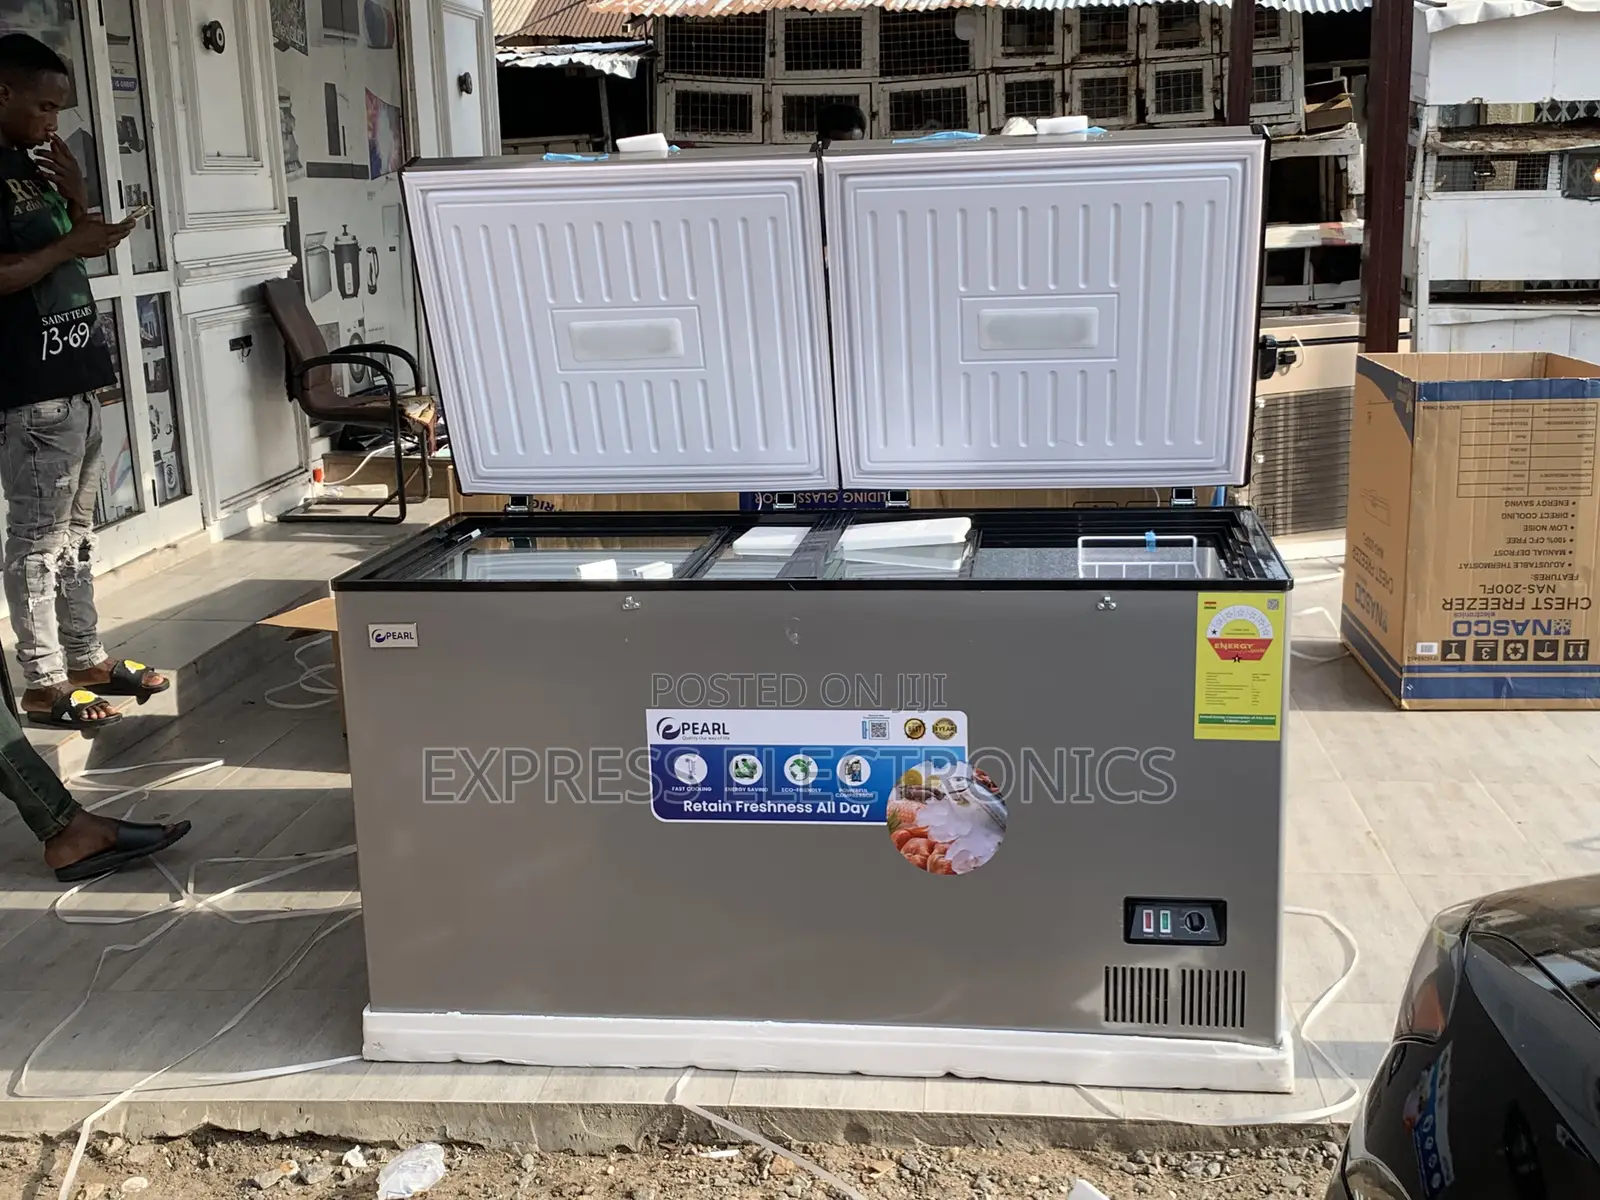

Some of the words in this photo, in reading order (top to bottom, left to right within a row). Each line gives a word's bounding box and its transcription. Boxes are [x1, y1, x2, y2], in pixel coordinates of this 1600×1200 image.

[41, 312, 70, 326] SAINT
[70, 305, 92, 320] TEARS
[42, 322, 90, 361] 13-69
[796, 492, 838, 503] GLASS
[843, 492, 886, 503] LIDING
[1479, 584, 1556, 594] NAS-200FL
[1442, 598, 1525, 610] FREEZER
[1532, 597, 1591, 610] CHEST
[1453, 619, 1552, 637] NASCO
[386, 631, 414, 640] PEARL
[1214, 642, 1253, 650] ENERGY
[1482, 648, 1490, 659] 3
[681, 722, 730, 735] PEARL
[684, 801, 732, 812] Retain
[736, 801, 812, 813] Freshness
[816, 801, 835, 814] All
[840, 802, 870, 818] Day
